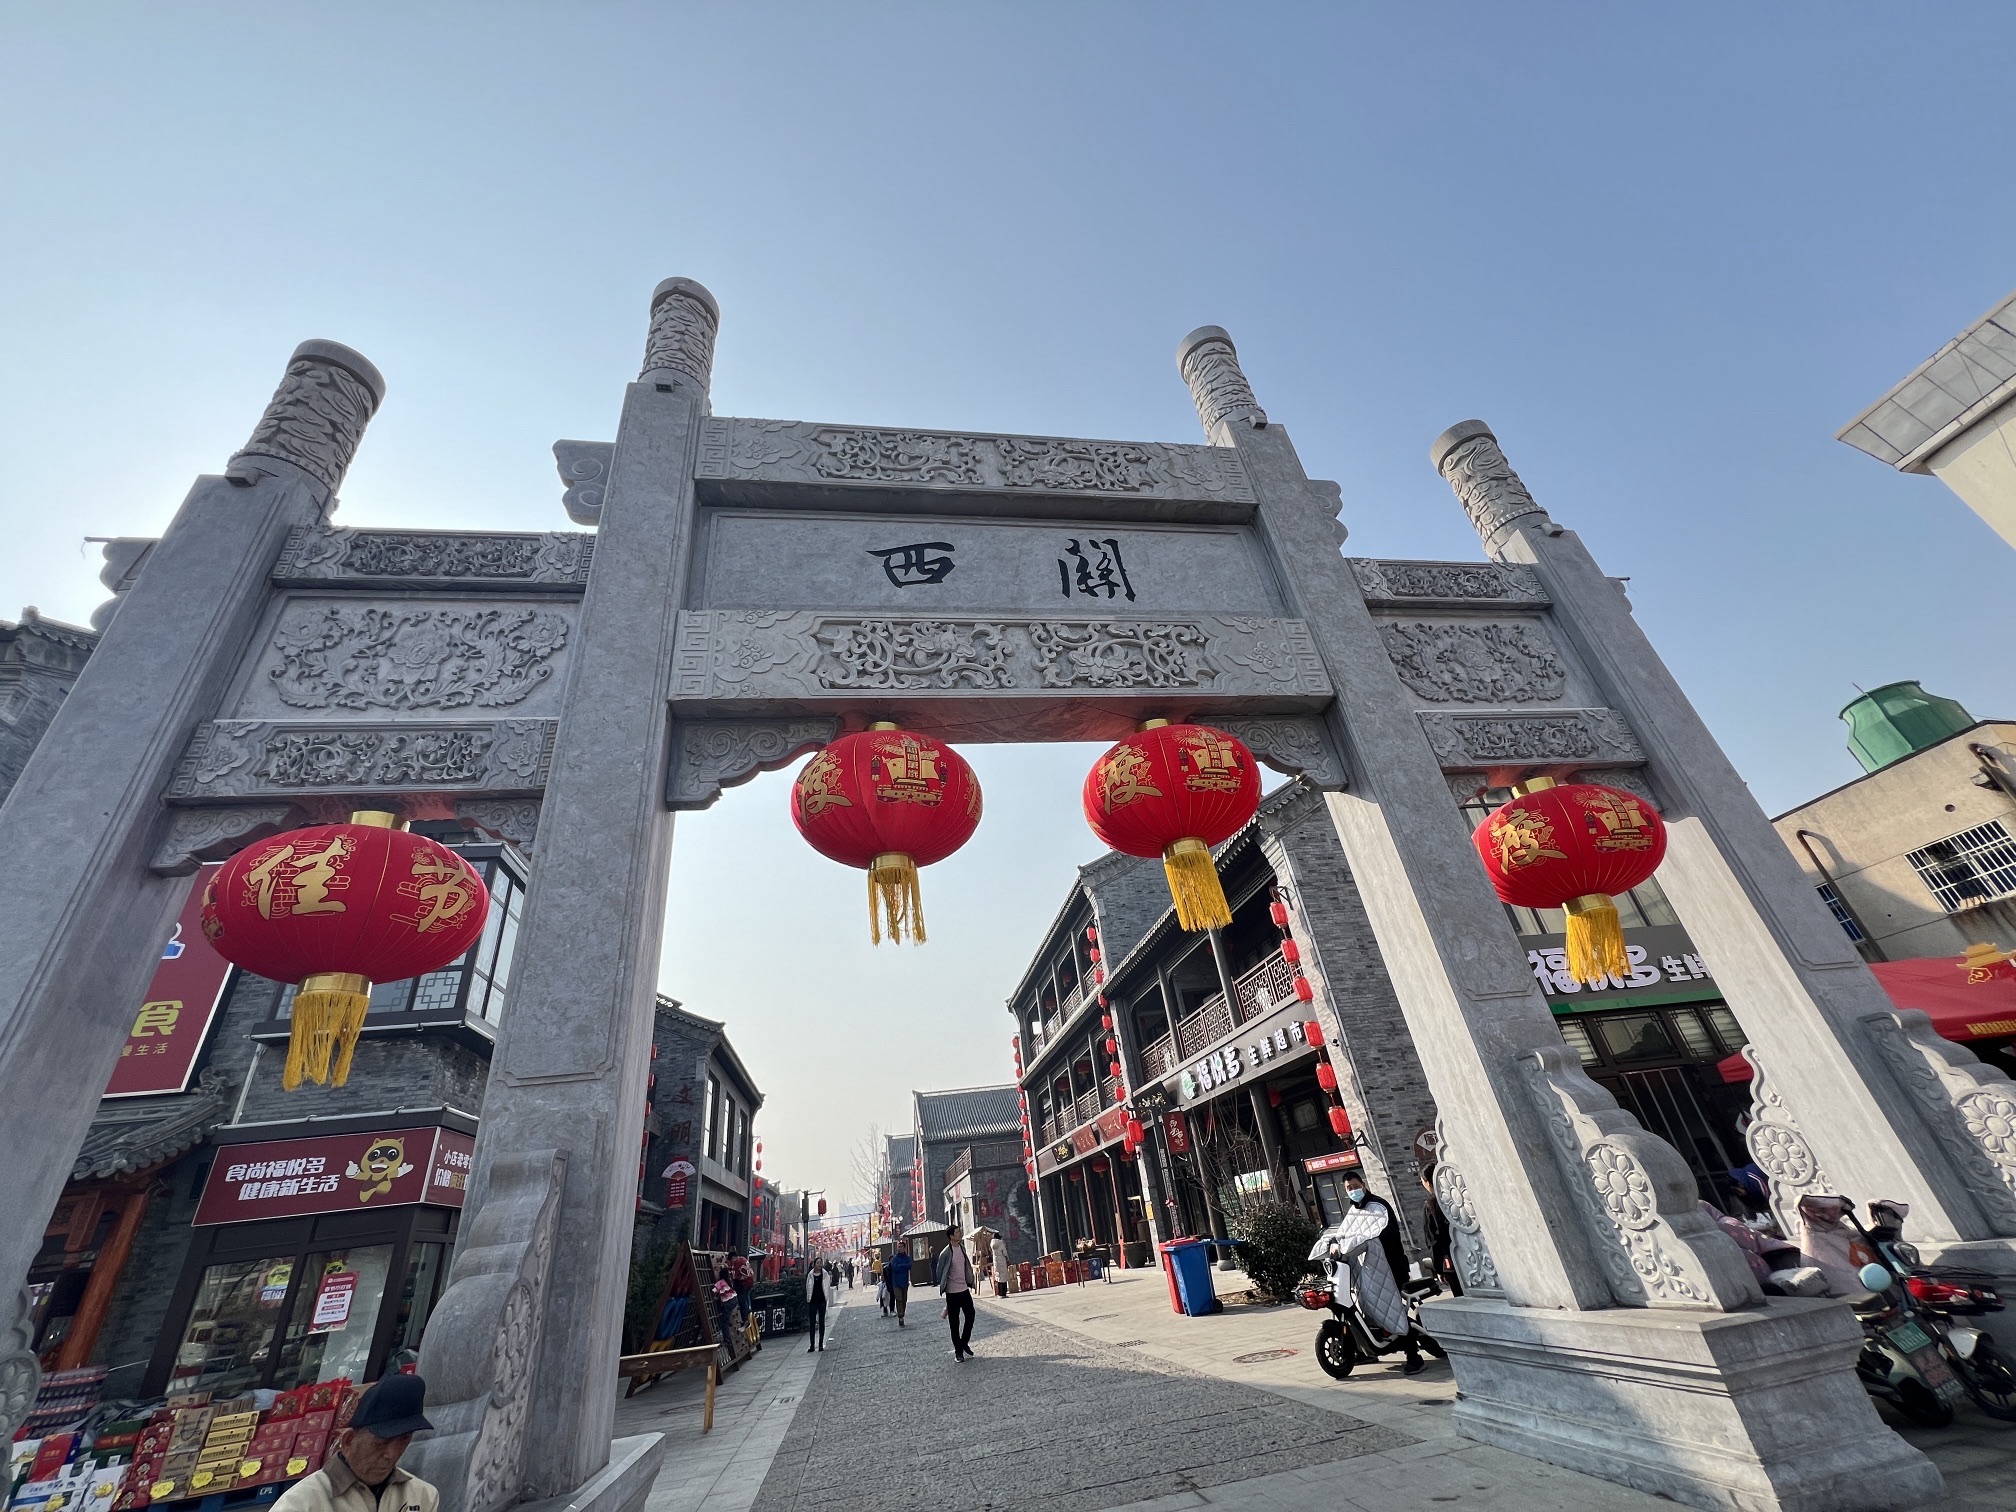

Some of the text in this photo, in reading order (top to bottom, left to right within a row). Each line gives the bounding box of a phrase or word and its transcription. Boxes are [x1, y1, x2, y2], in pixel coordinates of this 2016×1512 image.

[131, 1000, 183, 1037] 食
[1197, 1021, 1303, 1093] 福悦多 生鲜超市
[224, 1157, 327, 1183] 食尚福悦多
[238, 1174, 340, 1201] 健康新生活
